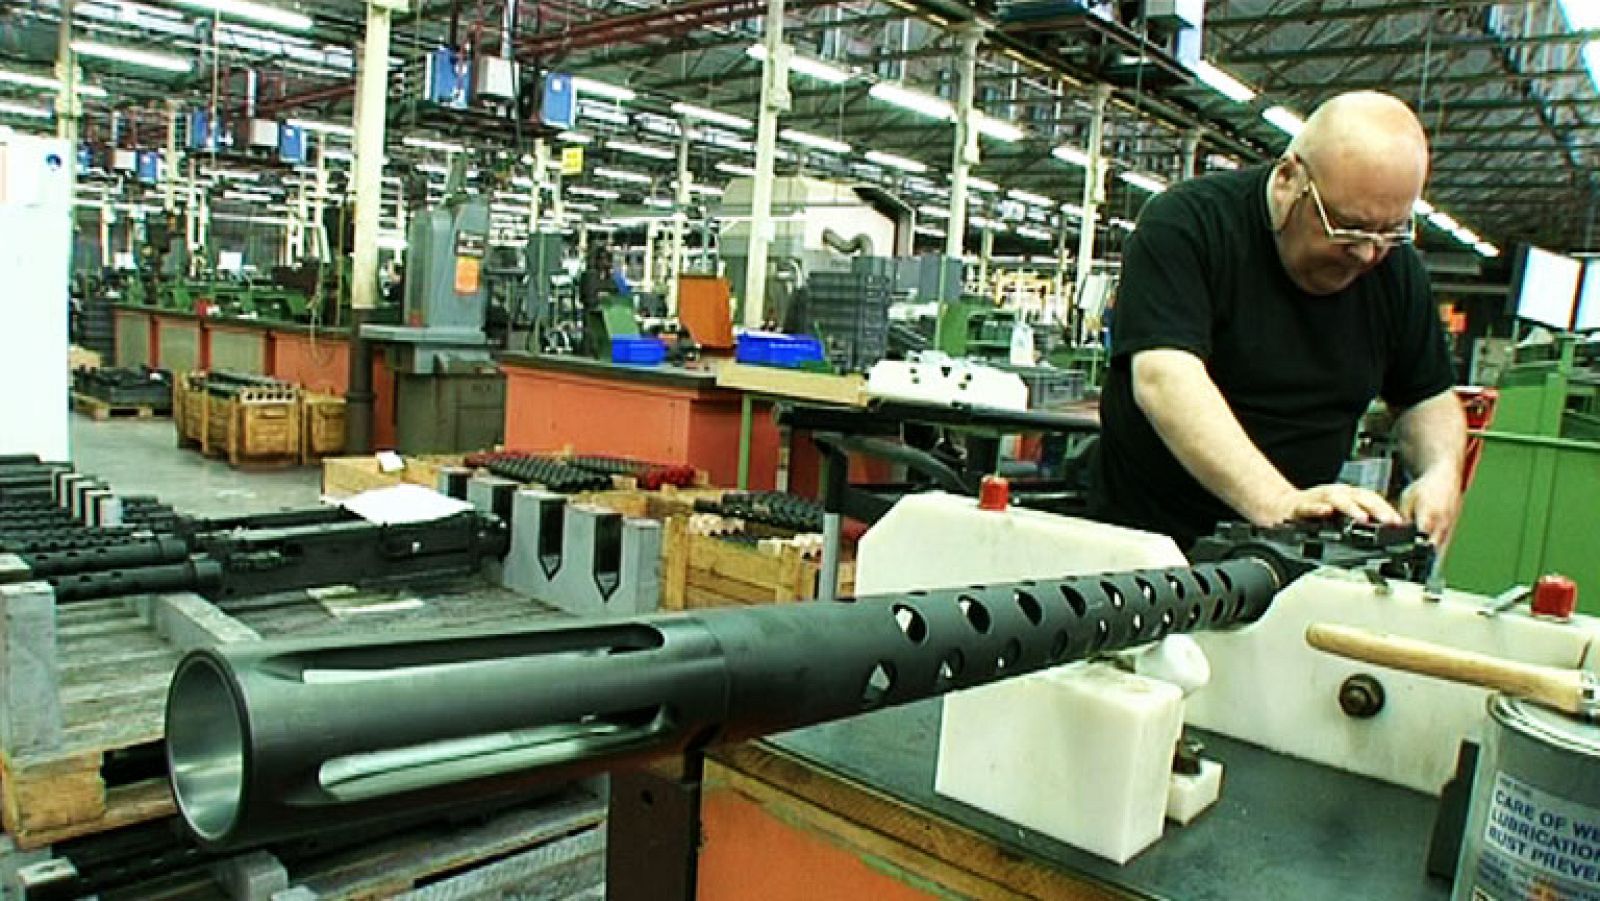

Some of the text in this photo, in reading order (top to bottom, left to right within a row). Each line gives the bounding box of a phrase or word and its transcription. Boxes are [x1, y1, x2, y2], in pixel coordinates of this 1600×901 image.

[1496, 789, 1534, 820] CARE
[1540, 812, 1567, 831] OF
[1489, 826, 1526, 855] RUST
